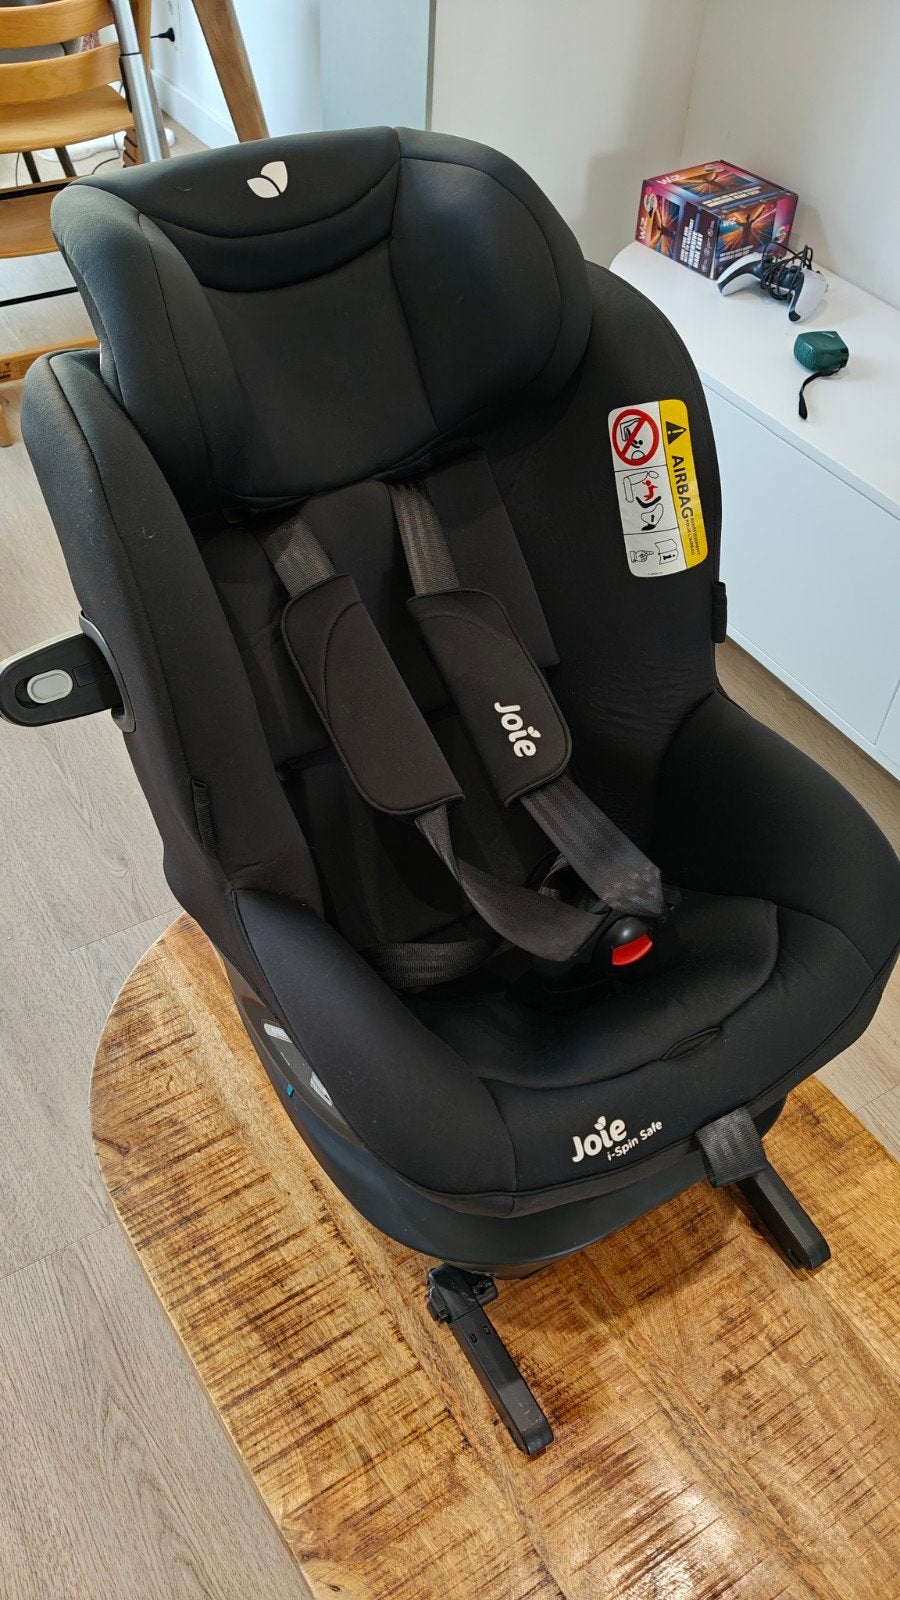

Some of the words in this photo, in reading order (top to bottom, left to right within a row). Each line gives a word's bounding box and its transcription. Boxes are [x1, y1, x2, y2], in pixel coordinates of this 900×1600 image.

[671, 455, 693, 519] AIRBAG
[494, 701, 541, 757] Joie
[572, 1115, 627, 1162] Joie
[606, 1137, 639, 1162] i-Spin
[639, 1121, 663, 1141] Safe
